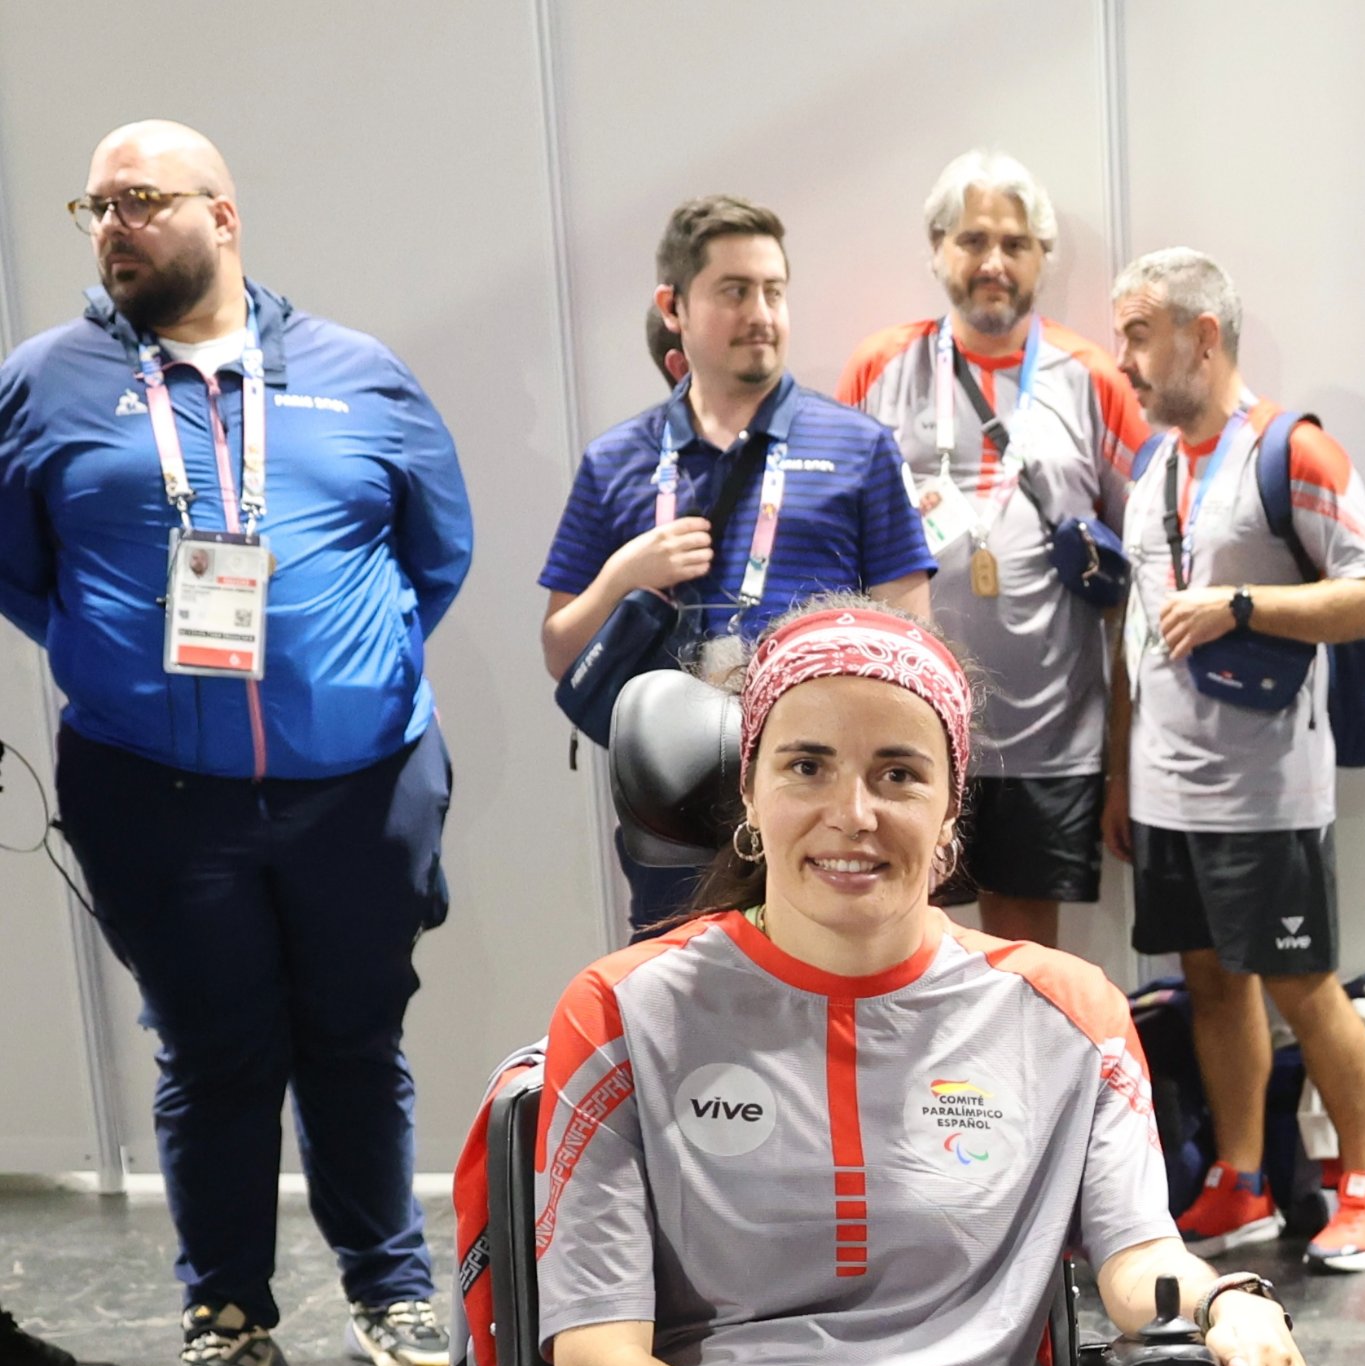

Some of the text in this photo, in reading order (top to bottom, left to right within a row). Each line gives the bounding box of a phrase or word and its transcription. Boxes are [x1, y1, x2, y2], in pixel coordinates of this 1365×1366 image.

[939, 1094, 984, 1106] COMITÉ
[689, 1096, 763, 1122] vive
[922, 1106, 1003, 1119] PARALÍMPICO
[937, 1118, 991, 1129] ESPAÑOL
